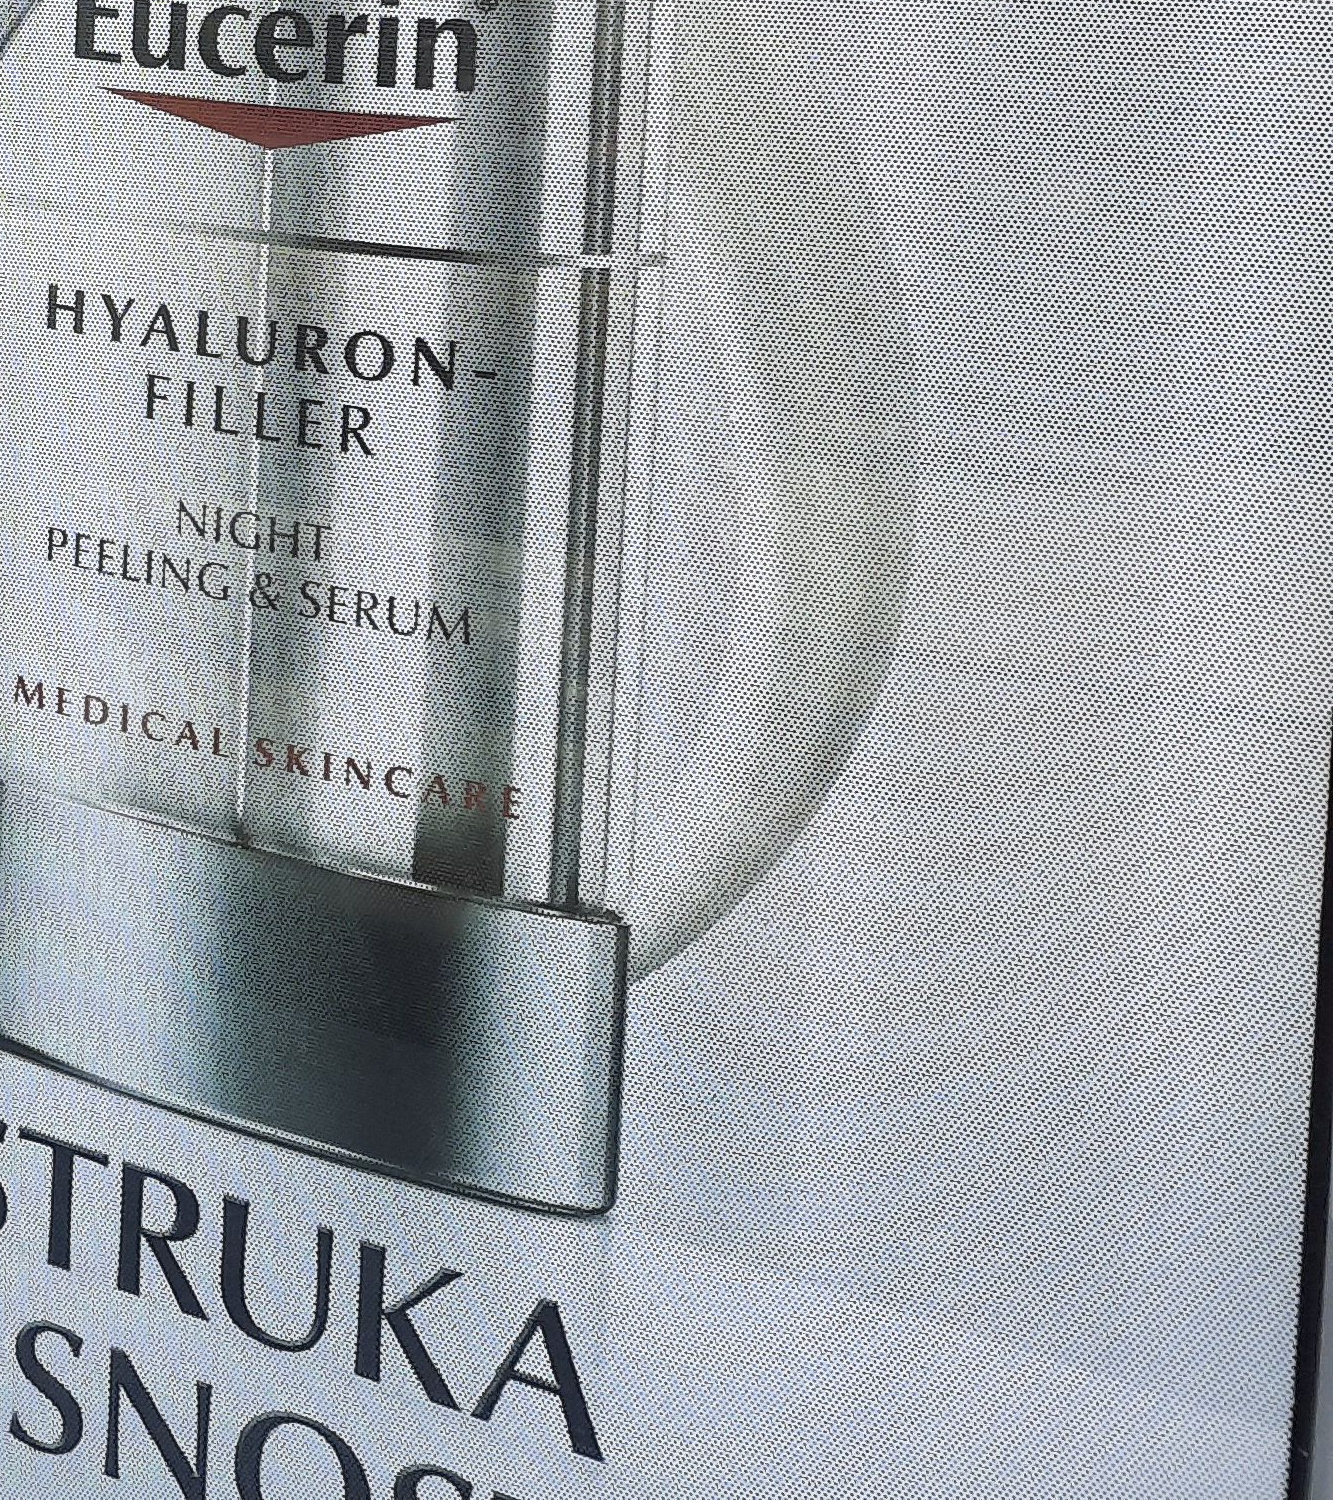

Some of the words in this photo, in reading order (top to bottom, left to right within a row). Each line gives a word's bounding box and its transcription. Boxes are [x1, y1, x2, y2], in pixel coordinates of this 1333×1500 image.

[45, 283, 497, 392] HYALURON-
[145, 373, 376, 457] FILLER
[46, 525, 232, 603] PEELING
[249, 572, 283, 611] &
[298, 579, 474, 646] SERUM
[176, 500, 333, 563] NIGHT
[13, 675, 232, 758] MEDICAL
[253, 738, 522, 821] SKINCARE
